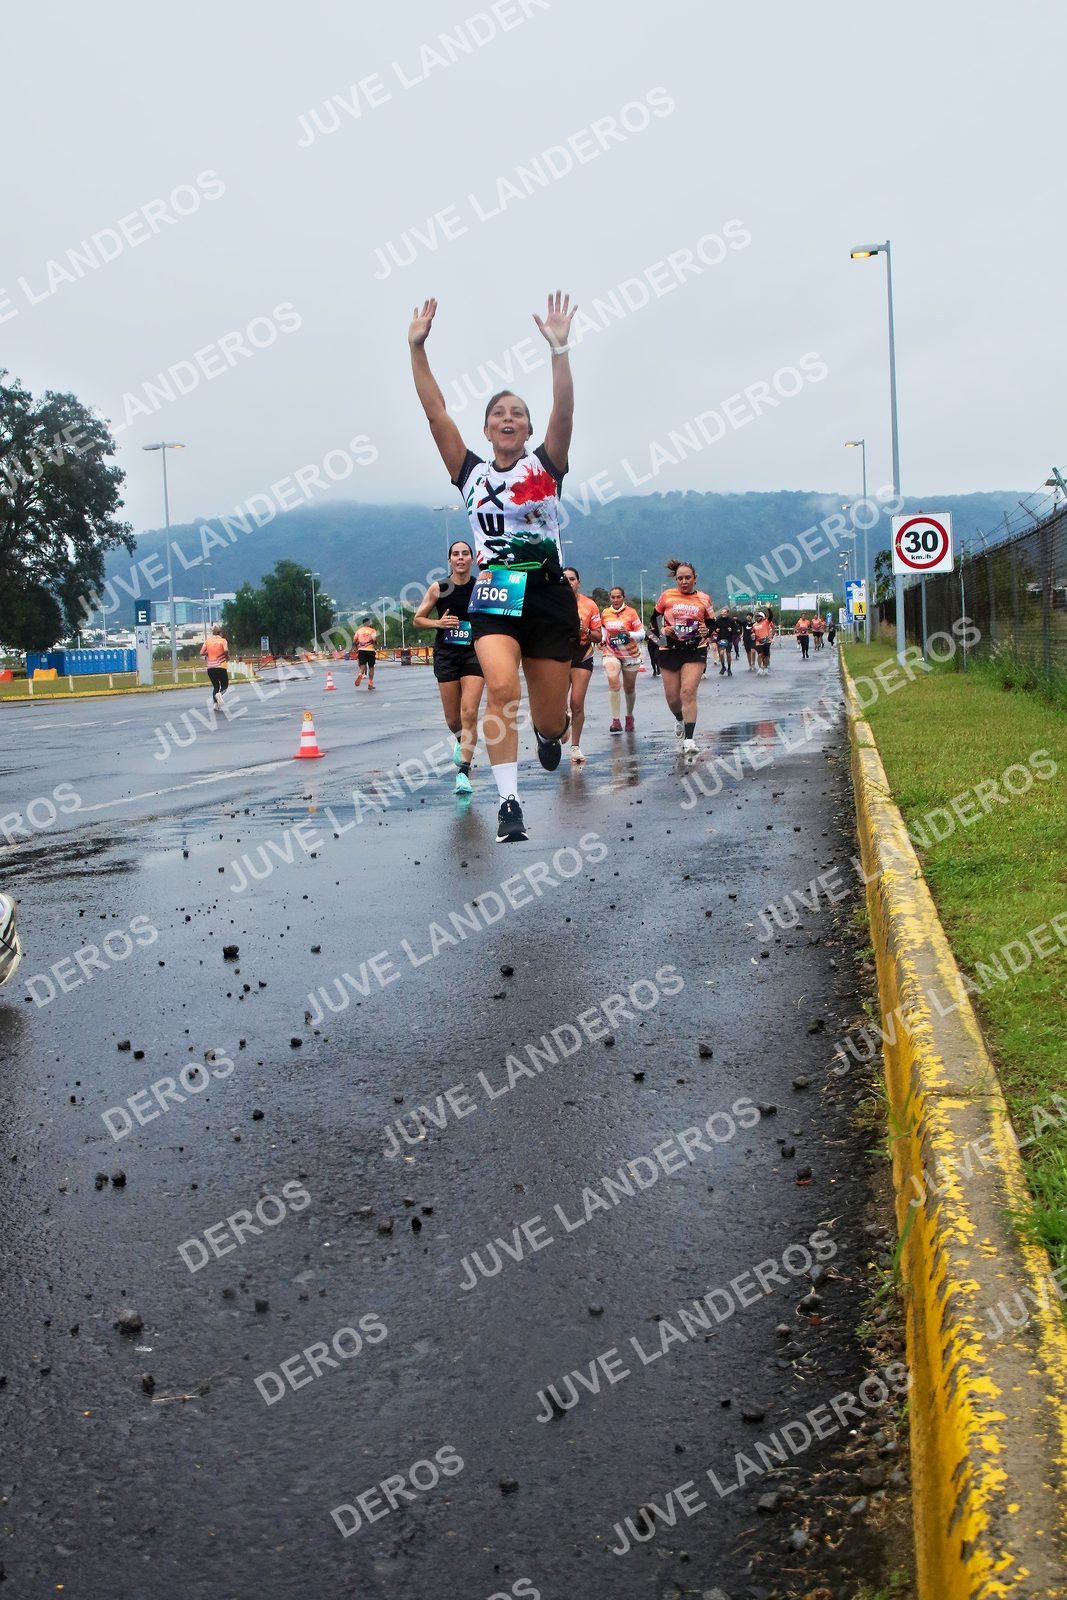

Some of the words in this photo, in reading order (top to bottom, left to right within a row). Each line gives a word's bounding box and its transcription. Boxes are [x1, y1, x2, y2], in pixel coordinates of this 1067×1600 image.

[904, 530, 939, 553] 30
[508, 573, 522, 585] 10K
[476, 587, 508, 602] 1506
[138, 610, 147, 622] E
[449, 629, 469, 638] 1389
[680, 625, 693, 633] 615
